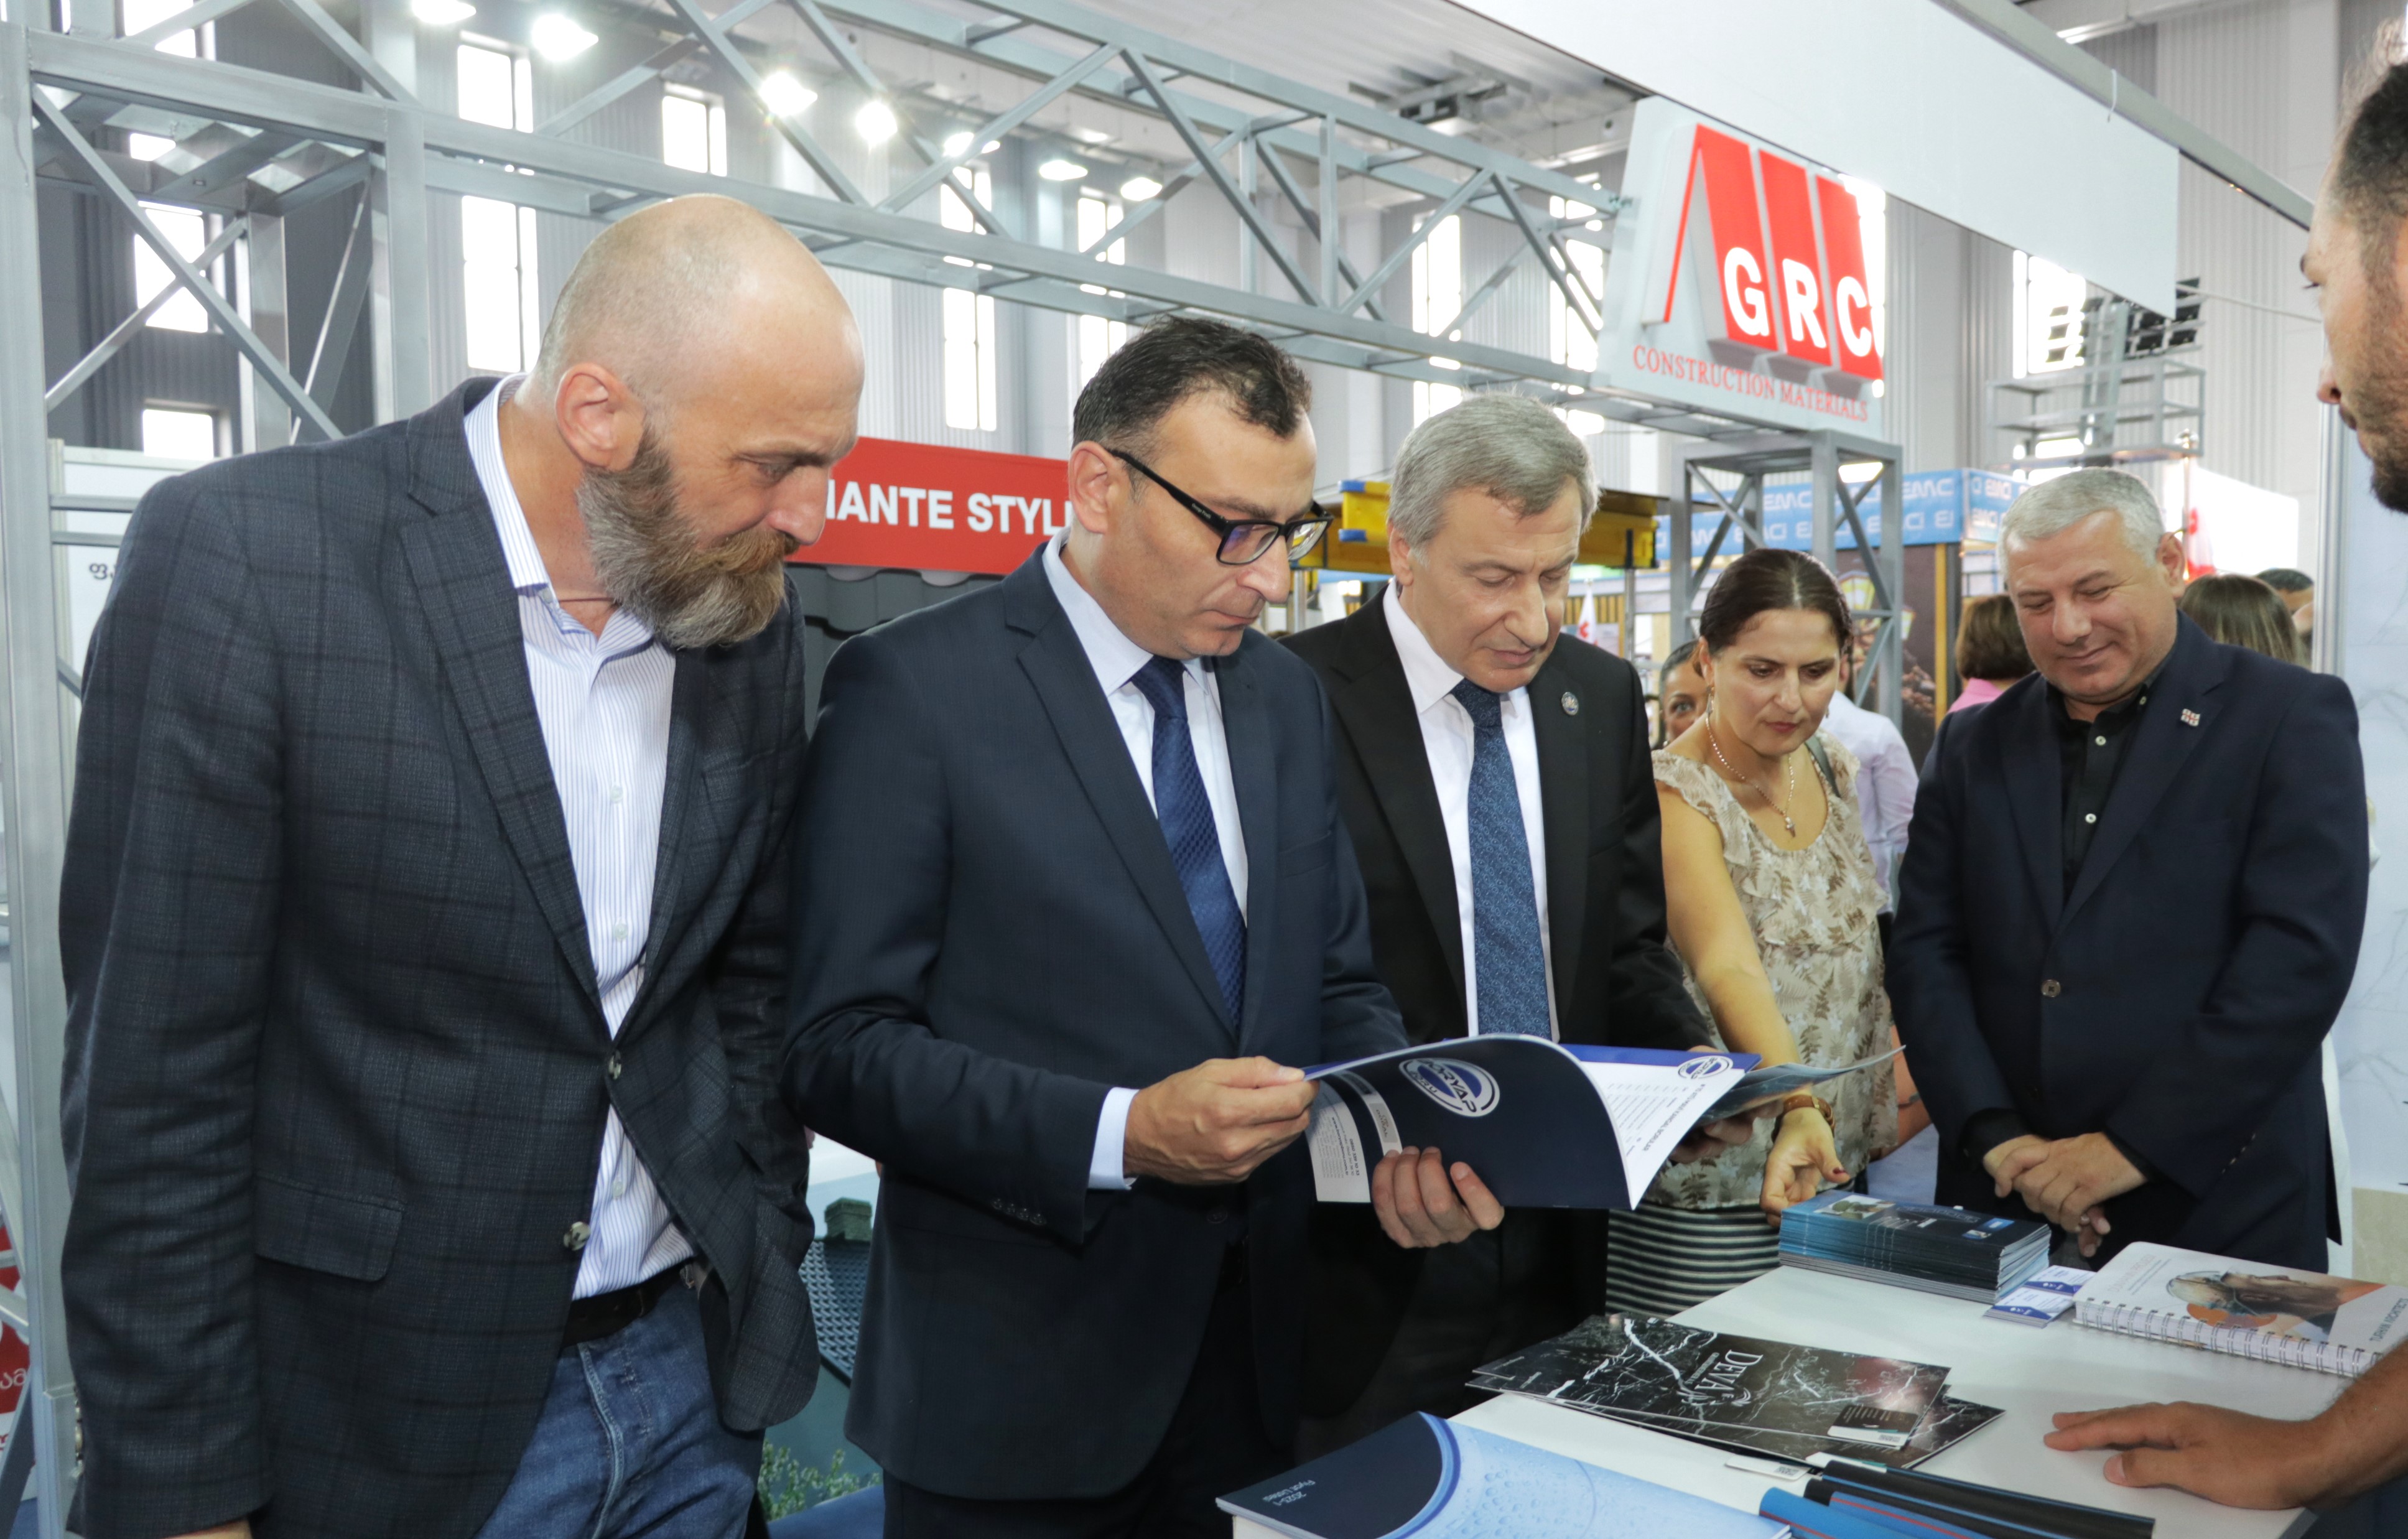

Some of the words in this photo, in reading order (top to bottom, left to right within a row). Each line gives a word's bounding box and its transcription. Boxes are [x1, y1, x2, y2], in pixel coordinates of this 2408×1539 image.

[1724, 247, 1872, 357] GRC
[1633, 344, 1776, 400] CONSTRUCTION
[1780, 381, 1868, 422] MATERIALS
[1694, 1349, 1764, 1391] DEVA
